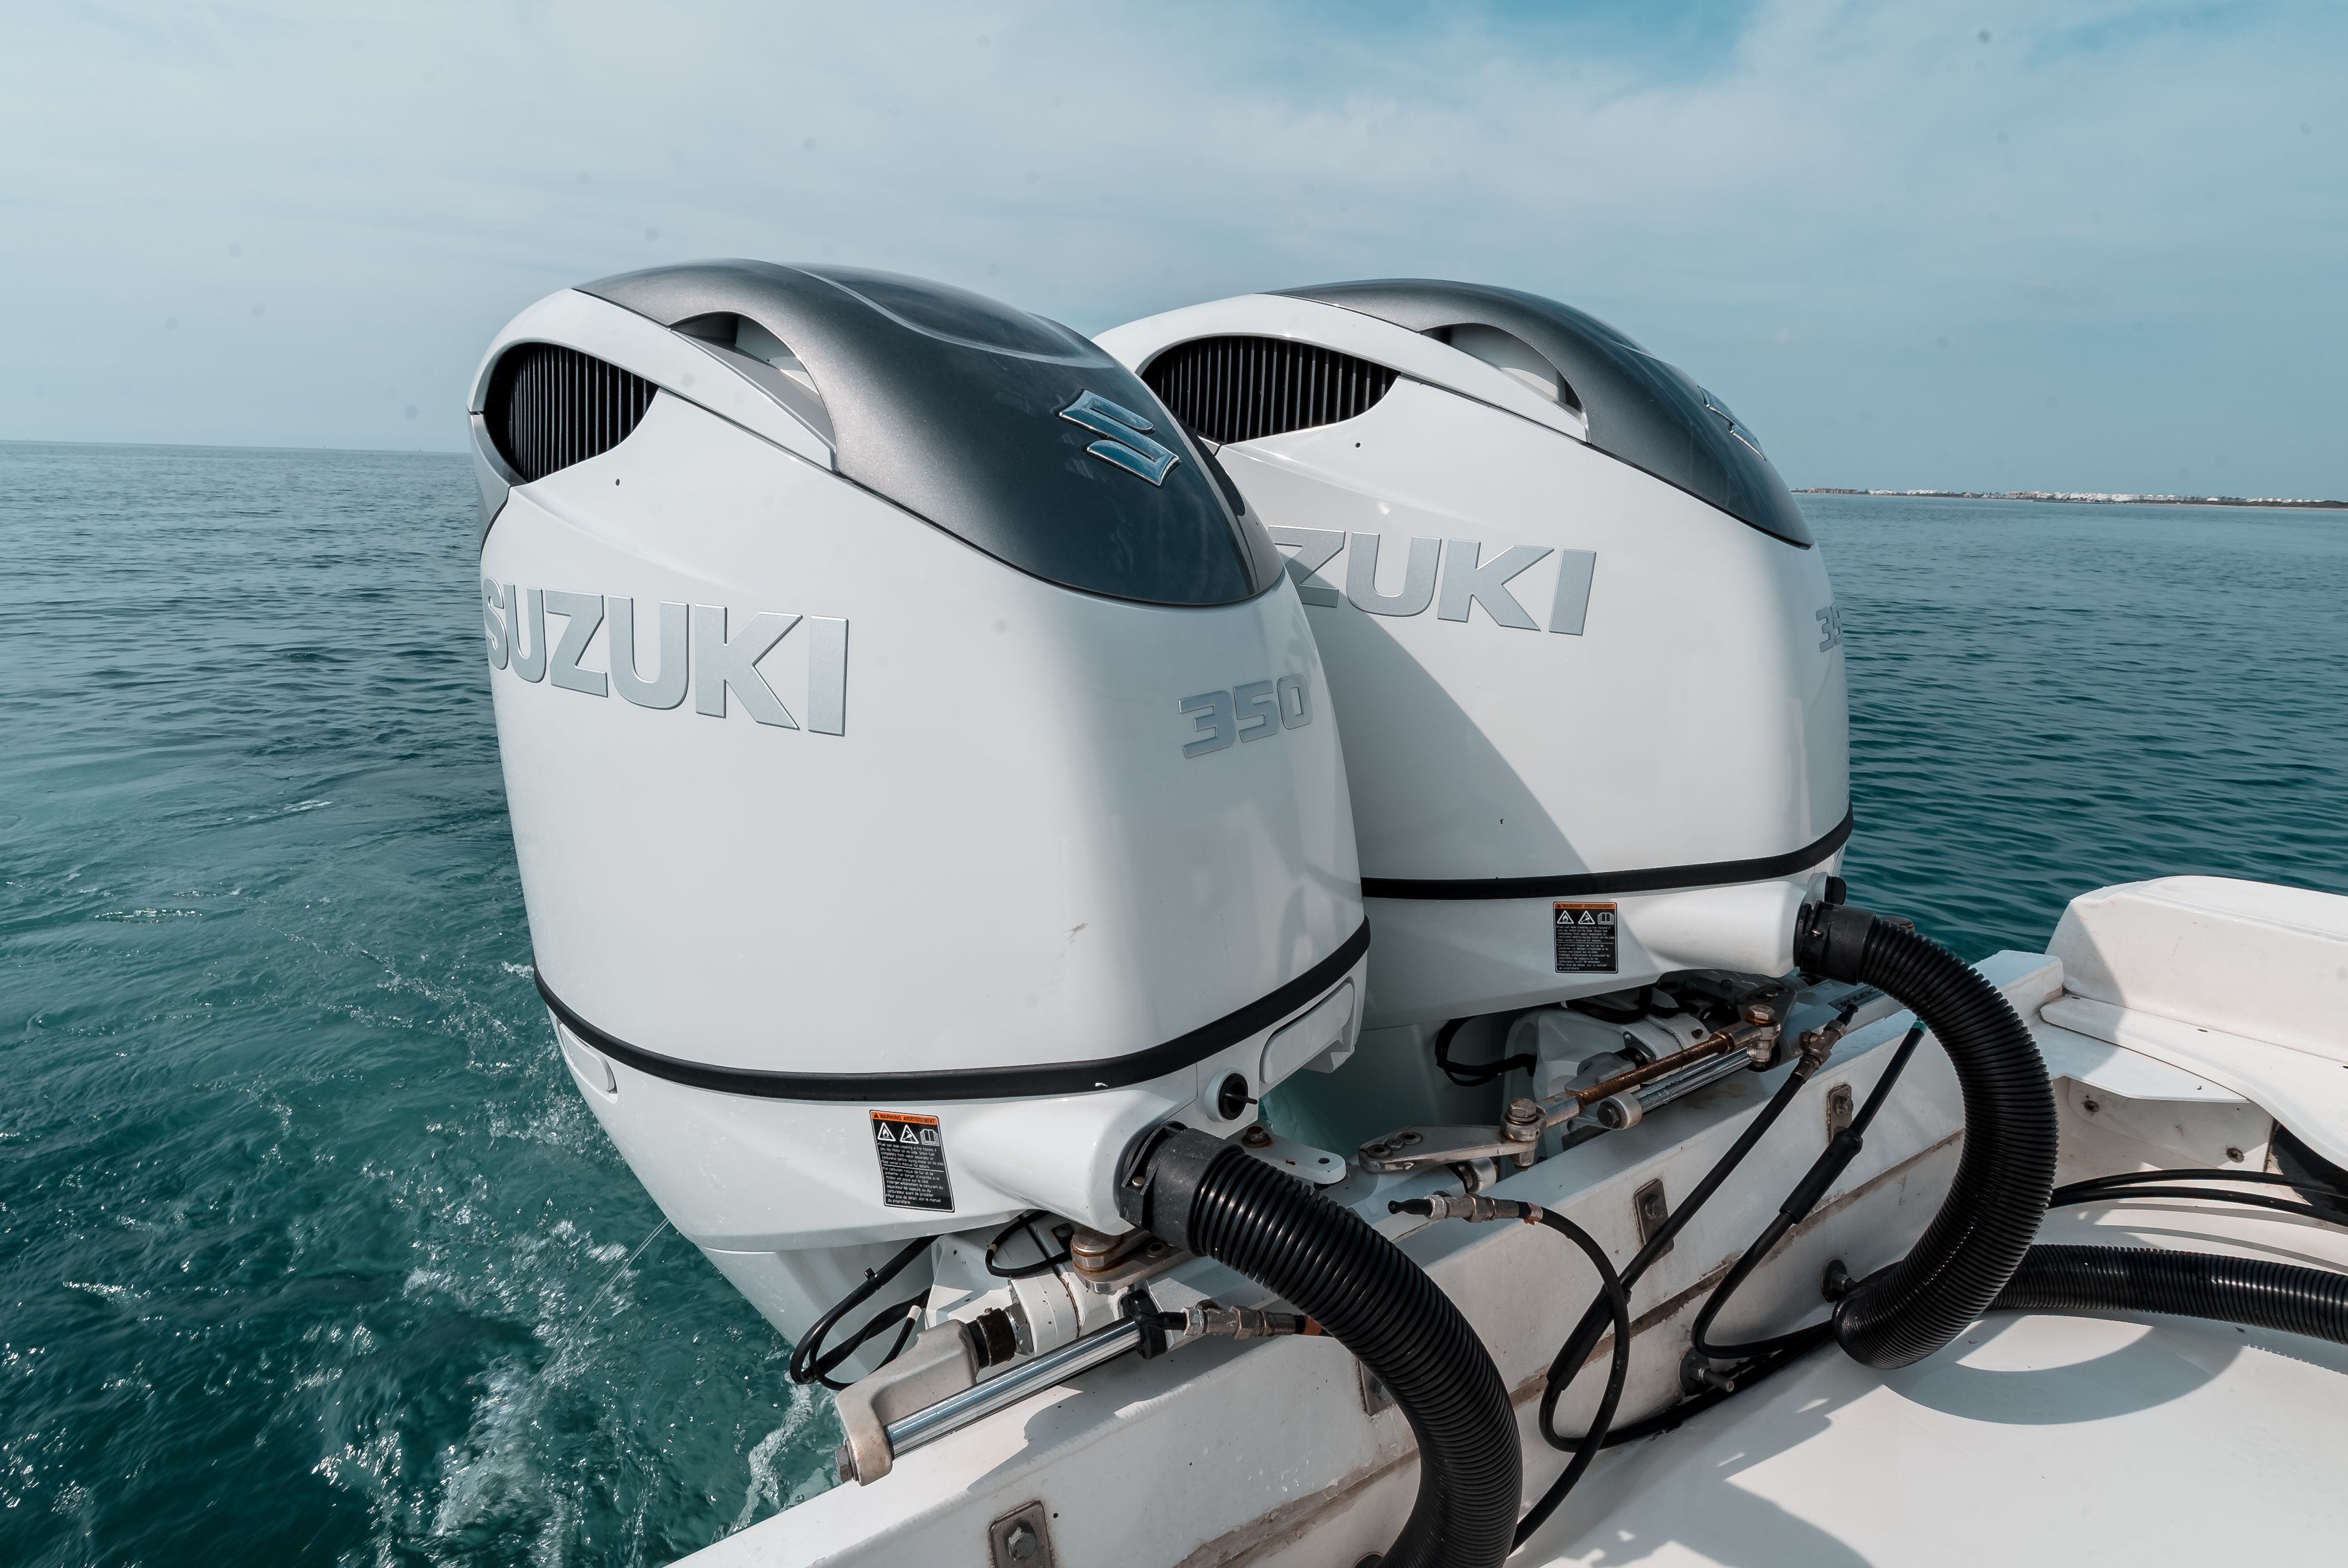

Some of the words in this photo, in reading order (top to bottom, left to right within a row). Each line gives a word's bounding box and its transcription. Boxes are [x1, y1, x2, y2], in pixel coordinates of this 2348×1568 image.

[1268, 525, 1597, 636] ZUKI
[483, 576, 848, 737] SUZUKI
[1178, 673, 1313, 760] 350
